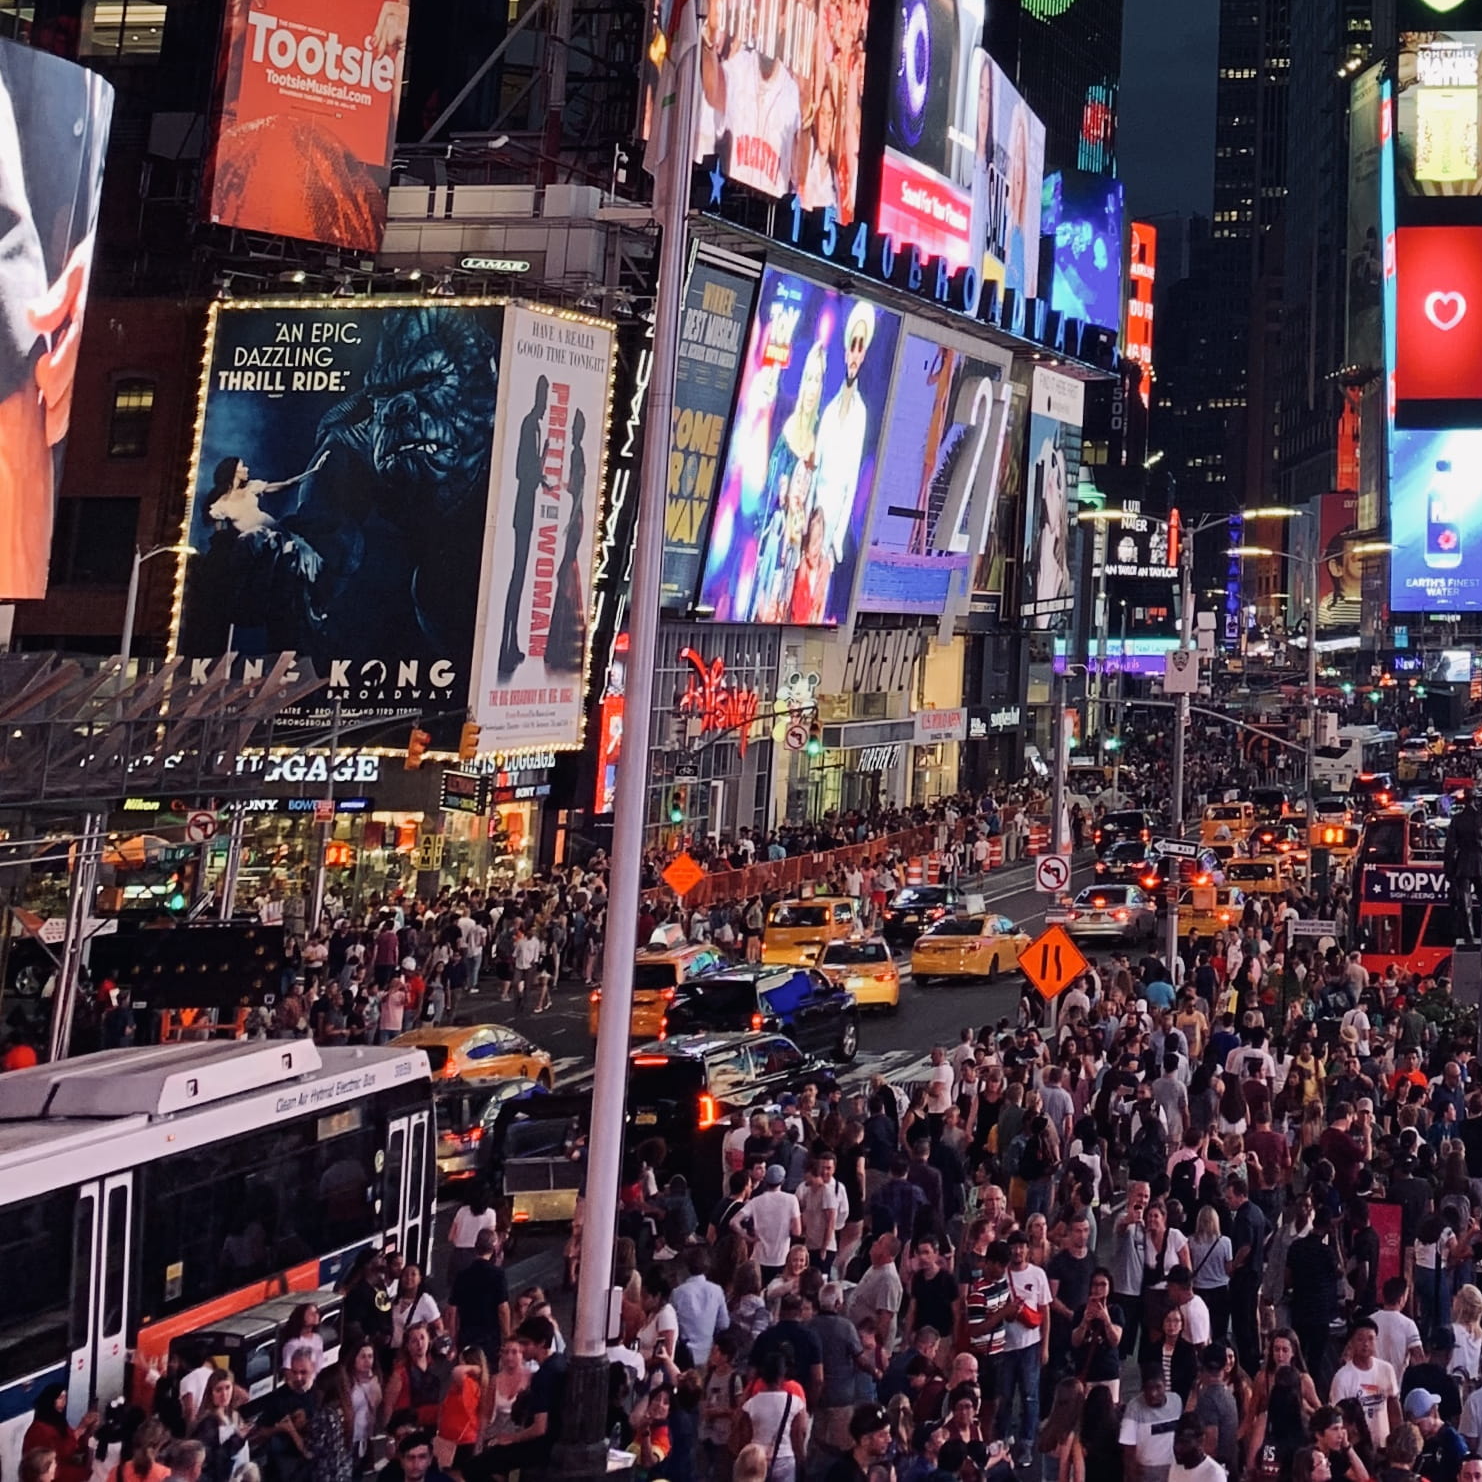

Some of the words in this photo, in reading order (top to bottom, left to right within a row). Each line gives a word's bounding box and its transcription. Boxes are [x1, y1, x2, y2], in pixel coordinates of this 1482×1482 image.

[248, 11, 395, 93] Tootsie
[1418, 50, 1476, 59] SOMETIMES
[266, 69, 372, 106] TootsieMusical.com
[790, 193, 894, 280] 1540
[466, 259, 527, 270] LAMAR
[908, 243, 1087, 356] BROADWAY
[312, 321, 362, 345] EPIC,
[532, 320, 555, 339] HAVE
[557, 326, 563, 341] A
[564, 329, 597, 351] REALLY
[704, 313, 741, 353] MUSICAL
[234, 347, 333, 367] DAZZLING
[516, 340, 543, 359] GOOD
[545, 346, 567, 364] TIME
[569, 350, 607, 375] TONIGHT
[218, 371, 286, 392] THRILL
[543, 382, 571, 504] PRETTY
[670, 451, 717, 498] ROM
[528, 525, 558, 658] WOMAN
[1406, 578, 1446, 588] EARTH'S
[1448, 578, 1480, 587] FINEST
[1426, 587, 1460, 597] WATER
[329, 659, 456, 688] KONG
[326, 689, 454, 700] BROADWAY
[217, 755, 380, 782] UGGAGE
[504, 751, 556, 771] LUGGAGE
[123, 798, 161, 811] Nikon
[1386, 871, 1450, 892] TOPV
